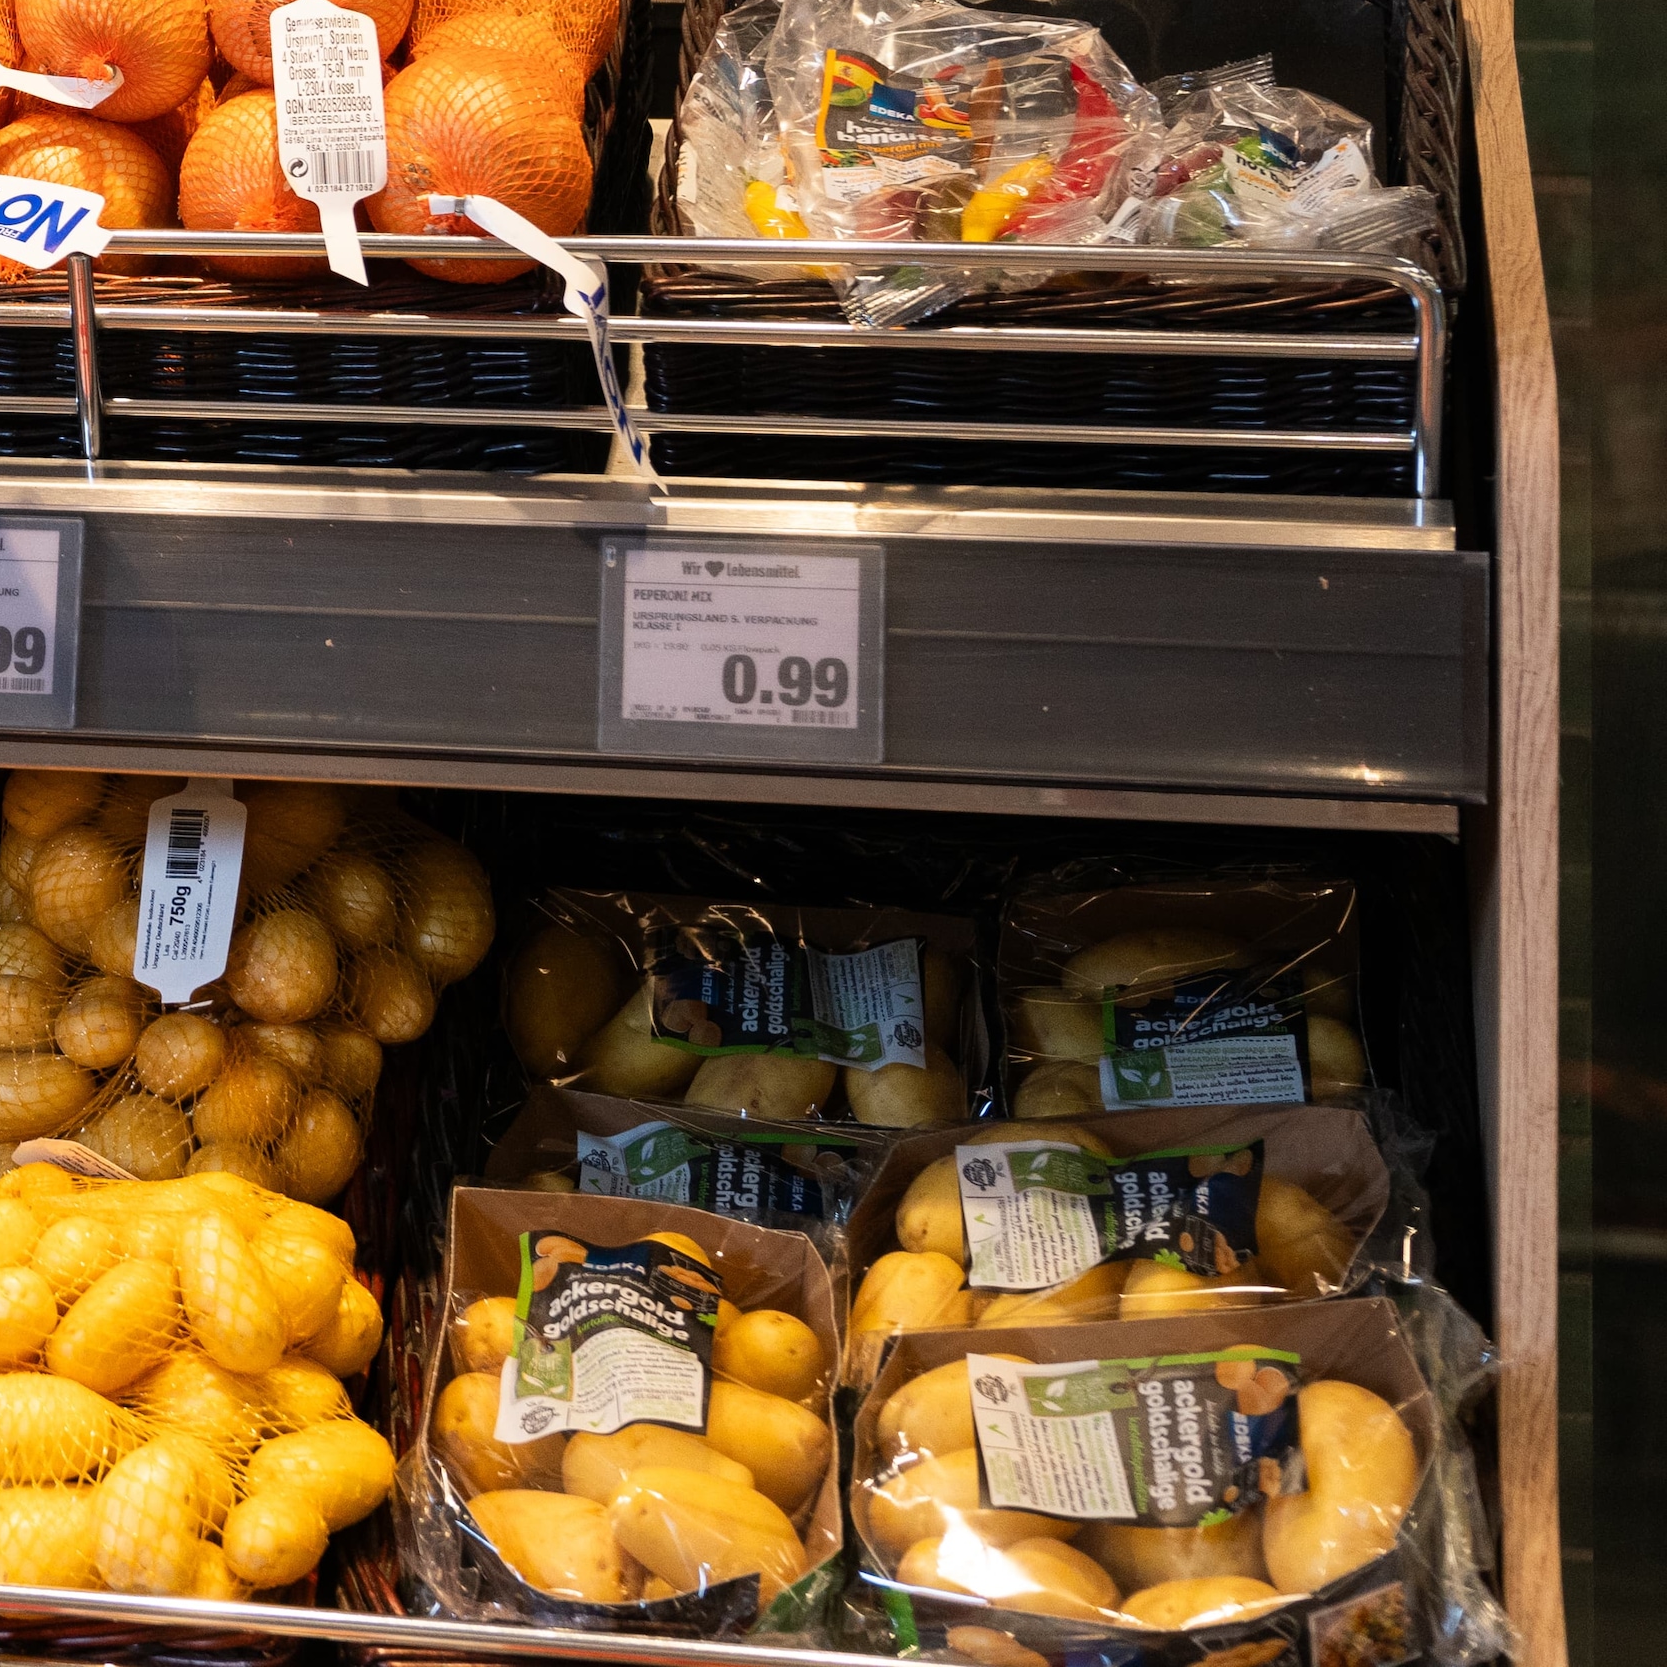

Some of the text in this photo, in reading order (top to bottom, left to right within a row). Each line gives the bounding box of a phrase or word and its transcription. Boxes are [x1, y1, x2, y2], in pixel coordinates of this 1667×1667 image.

[329, 32, 363, 46] Spanien
[347, 48, 369, 62] Netto
[322, 64, 345, 78] 75-90
[348, 65, 365, 77] mm
[329, 80, 355, 94] Klasse
[869, 104, 916, 122] EDEKA
[681, 561, 700, 576] Wir
[633, 589, 713, 602] PEPERONI MIX
[633, 612, 728, 623] URSPRUNGSLAND
[744, 615, 818, 626] VERPACKUNG
[633, 622, 673, 630] KLASSE
[722, 654, 849, 707] 0.99
[155, 903, 165, 940] Deutschland
[169, 885, 191, 926] 750g
[739, 947, 763, 1034] ackergold
[765, 943, 791, 1036] goldschalige
[790, 1174, 804, 1212] EDEKA
[542, 1297, 690, 1341] goldschalige
[549, 1280, 686, 1326] ackergold
[1137, 1380, 1178, 1511] goldschalige
[1172, 1380, 1215, 1504] ackergold
[1233, 1411, 1253, 1464] EDEKA
